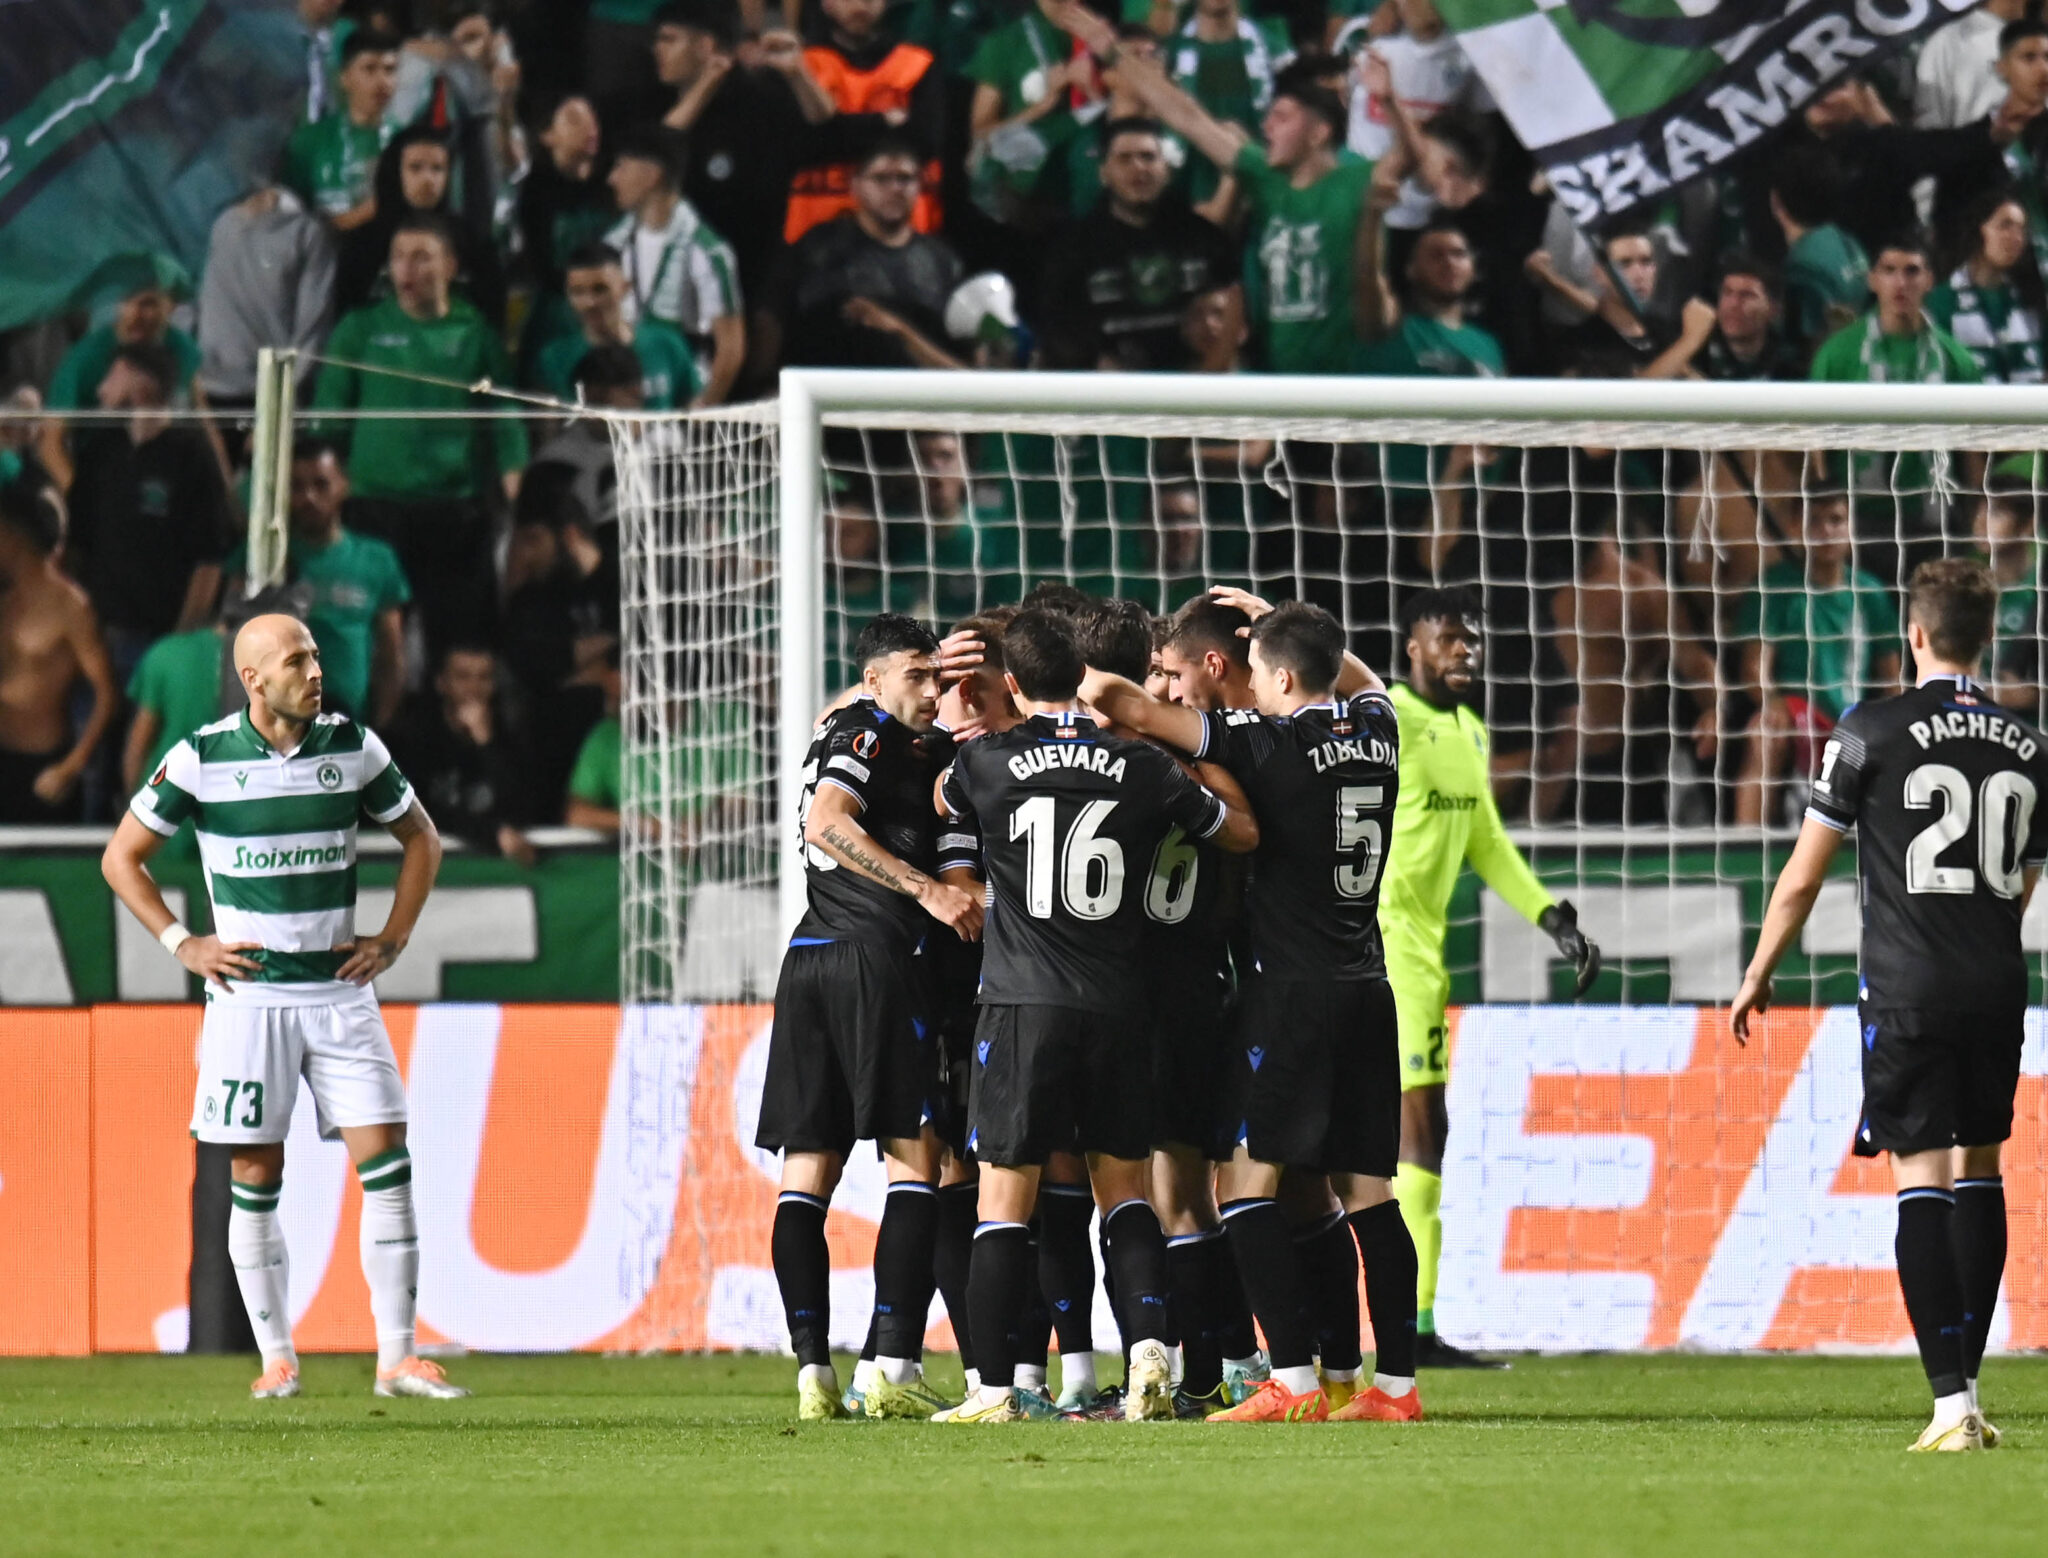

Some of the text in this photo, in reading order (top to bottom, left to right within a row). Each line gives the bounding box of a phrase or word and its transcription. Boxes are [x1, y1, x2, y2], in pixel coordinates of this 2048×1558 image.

[1545, 0, 1978, 226] SHAMRO
[1007, 743, 1128, 784] GUEVARA
[1908, 711, 2038, 762] PACHECO
[232, 845, 347, 870] Stoiximan
[1009, 796, 1126, 921] 16
[1333, 785, 1384, 899] 5
[1903, 763, 2038, 900] 20
[221, 1079, 264, 1129] 73
[1433, 1005, 2048, 1352] EA
